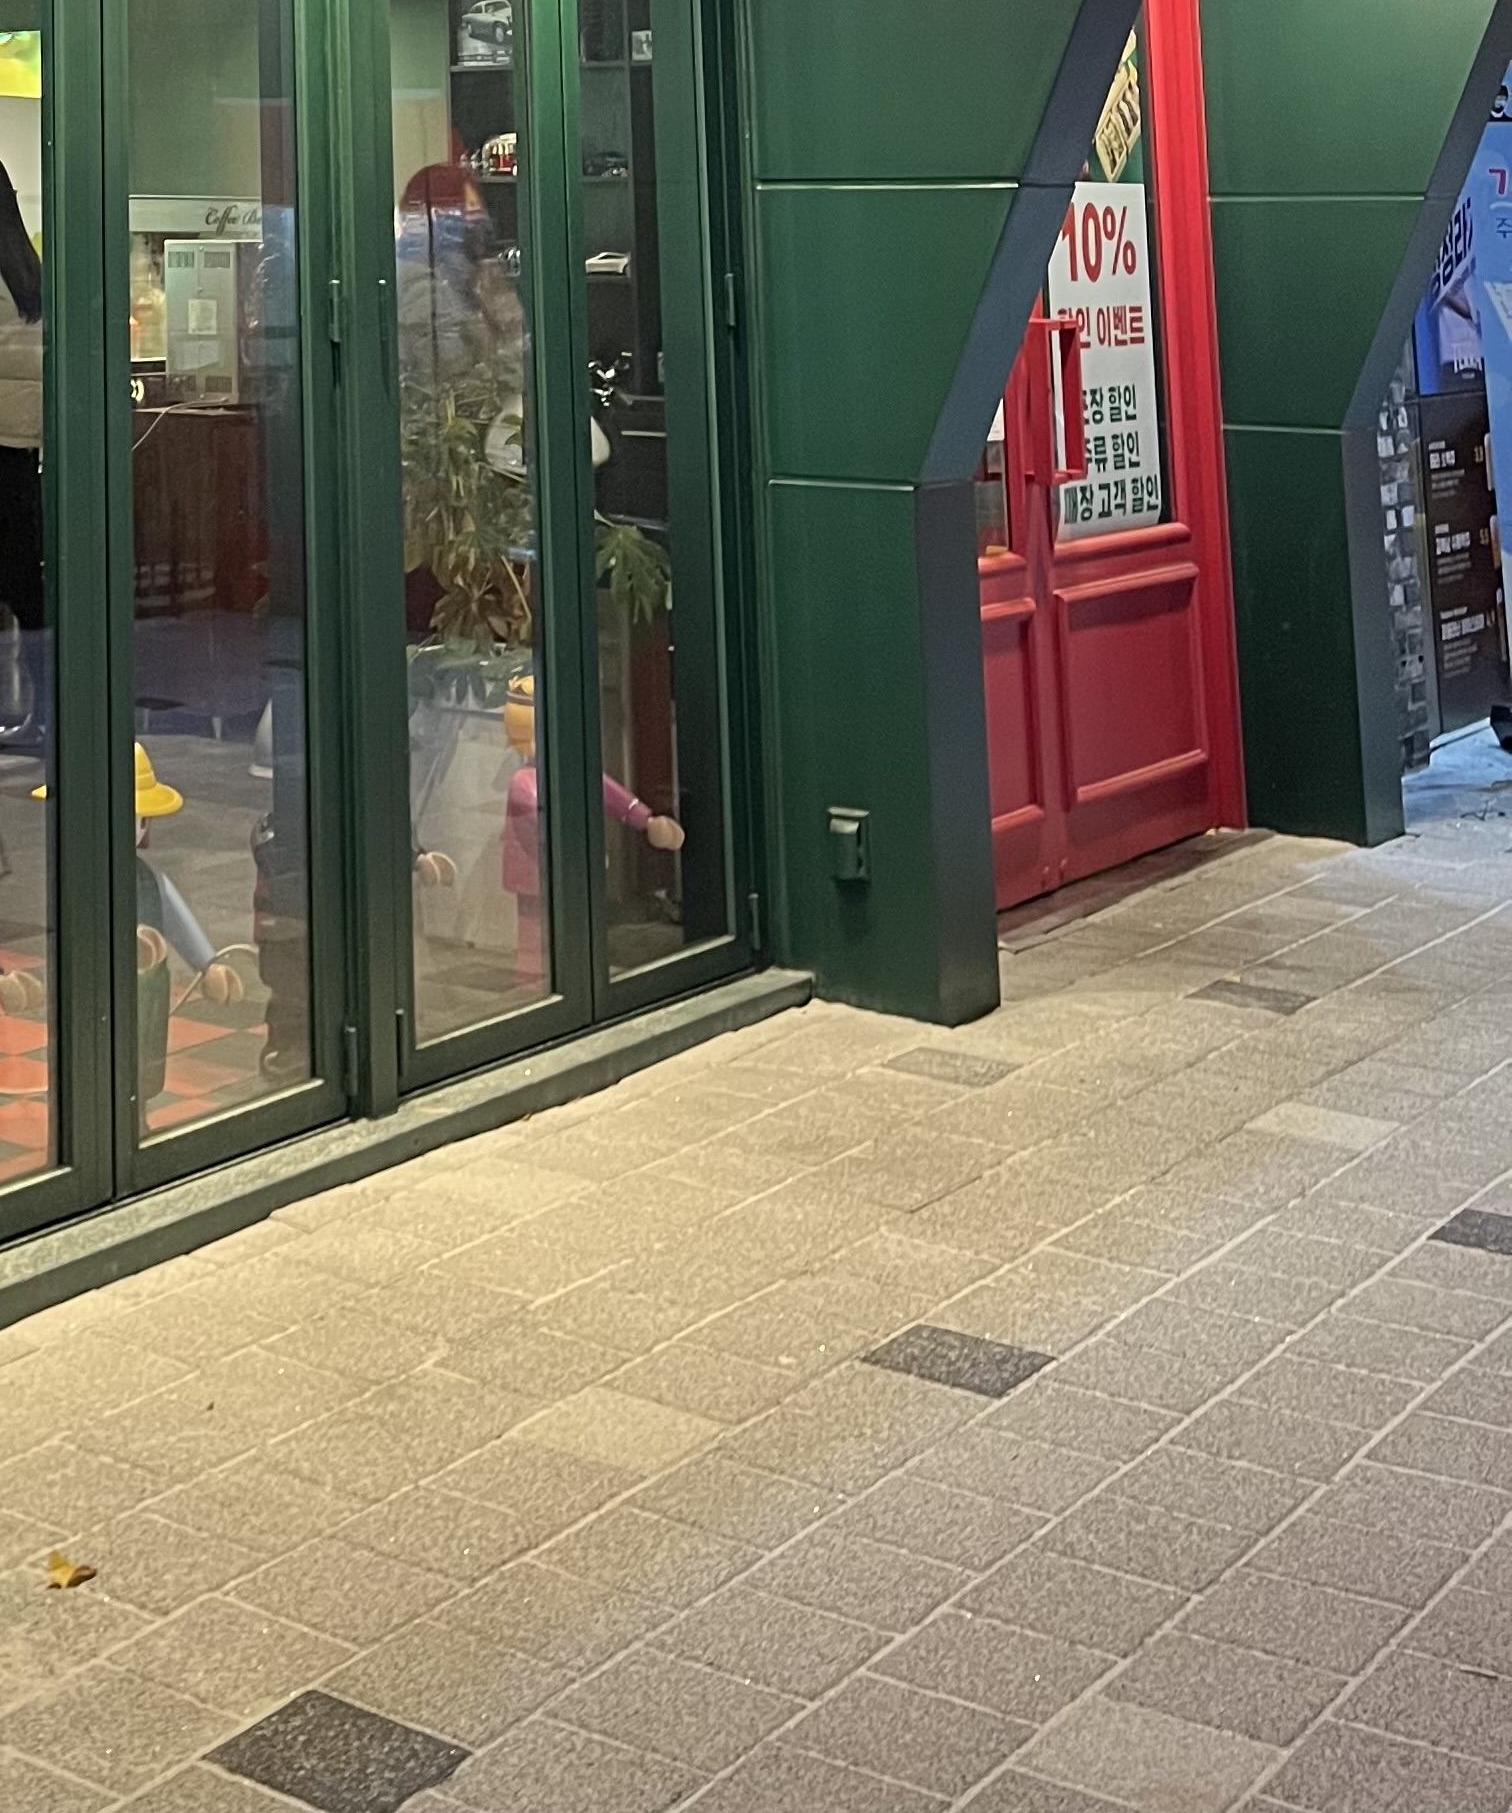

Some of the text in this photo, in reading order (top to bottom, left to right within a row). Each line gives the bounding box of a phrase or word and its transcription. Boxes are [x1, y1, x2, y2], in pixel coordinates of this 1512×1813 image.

[1059, 201, 1139, 283] 10%
[1097, 305, 1145, 347] 이벤트
[1108, 384, 1137, 423] 할인
[1111, 431, 1140, 470] 할인
[1098, 479, 1126, 519] 고객
[1131, 474, 1158, 514] 할인
